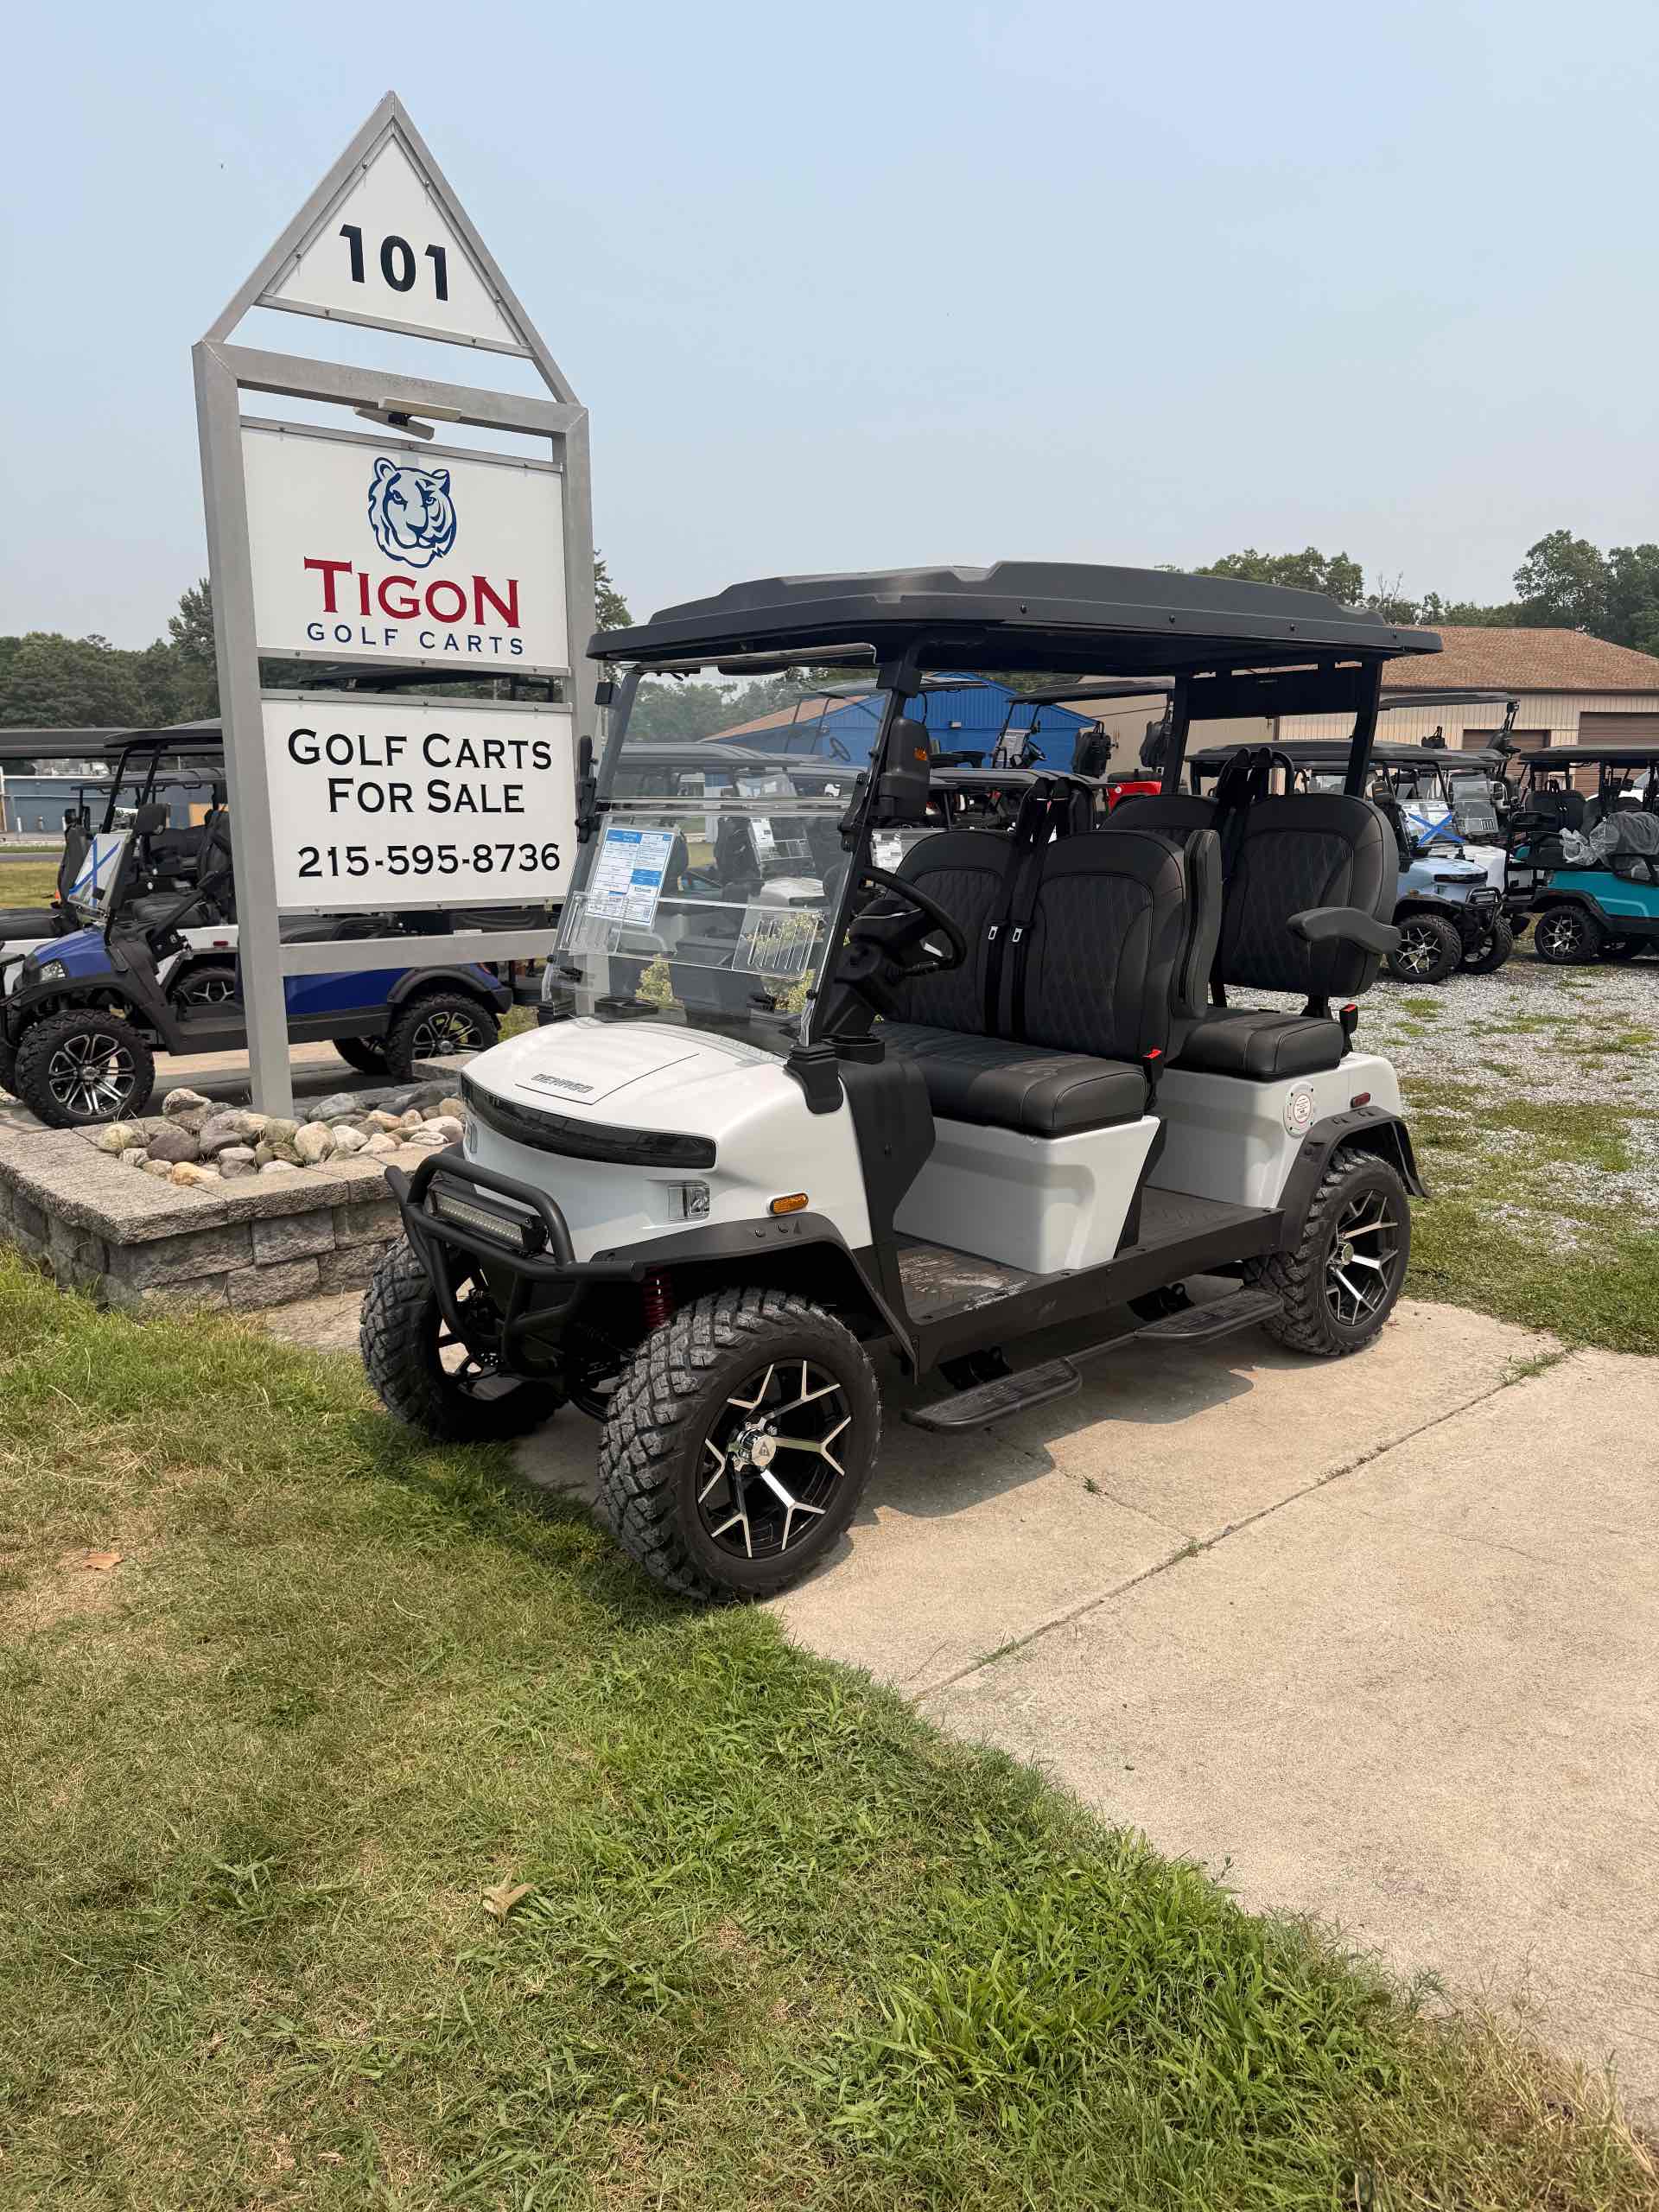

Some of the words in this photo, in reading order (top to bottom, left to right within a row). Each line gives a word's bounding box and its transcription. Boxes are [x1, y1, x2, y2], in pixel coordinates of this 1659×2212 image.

[340, 225, 448, 302] 101
[303, 556, 521, 629] TIGON
[307, 622, 398, 646] GOLF
[419, 631, 523, 656] CARTS
[288, 728, 408, 766] GOLF
[423, 733, 552, 770] CARTS
[327, 778, 415, 813] FOR
[427, 779, 525, 814] SALE
[297, 842, 560, 878] 215-595-8736
